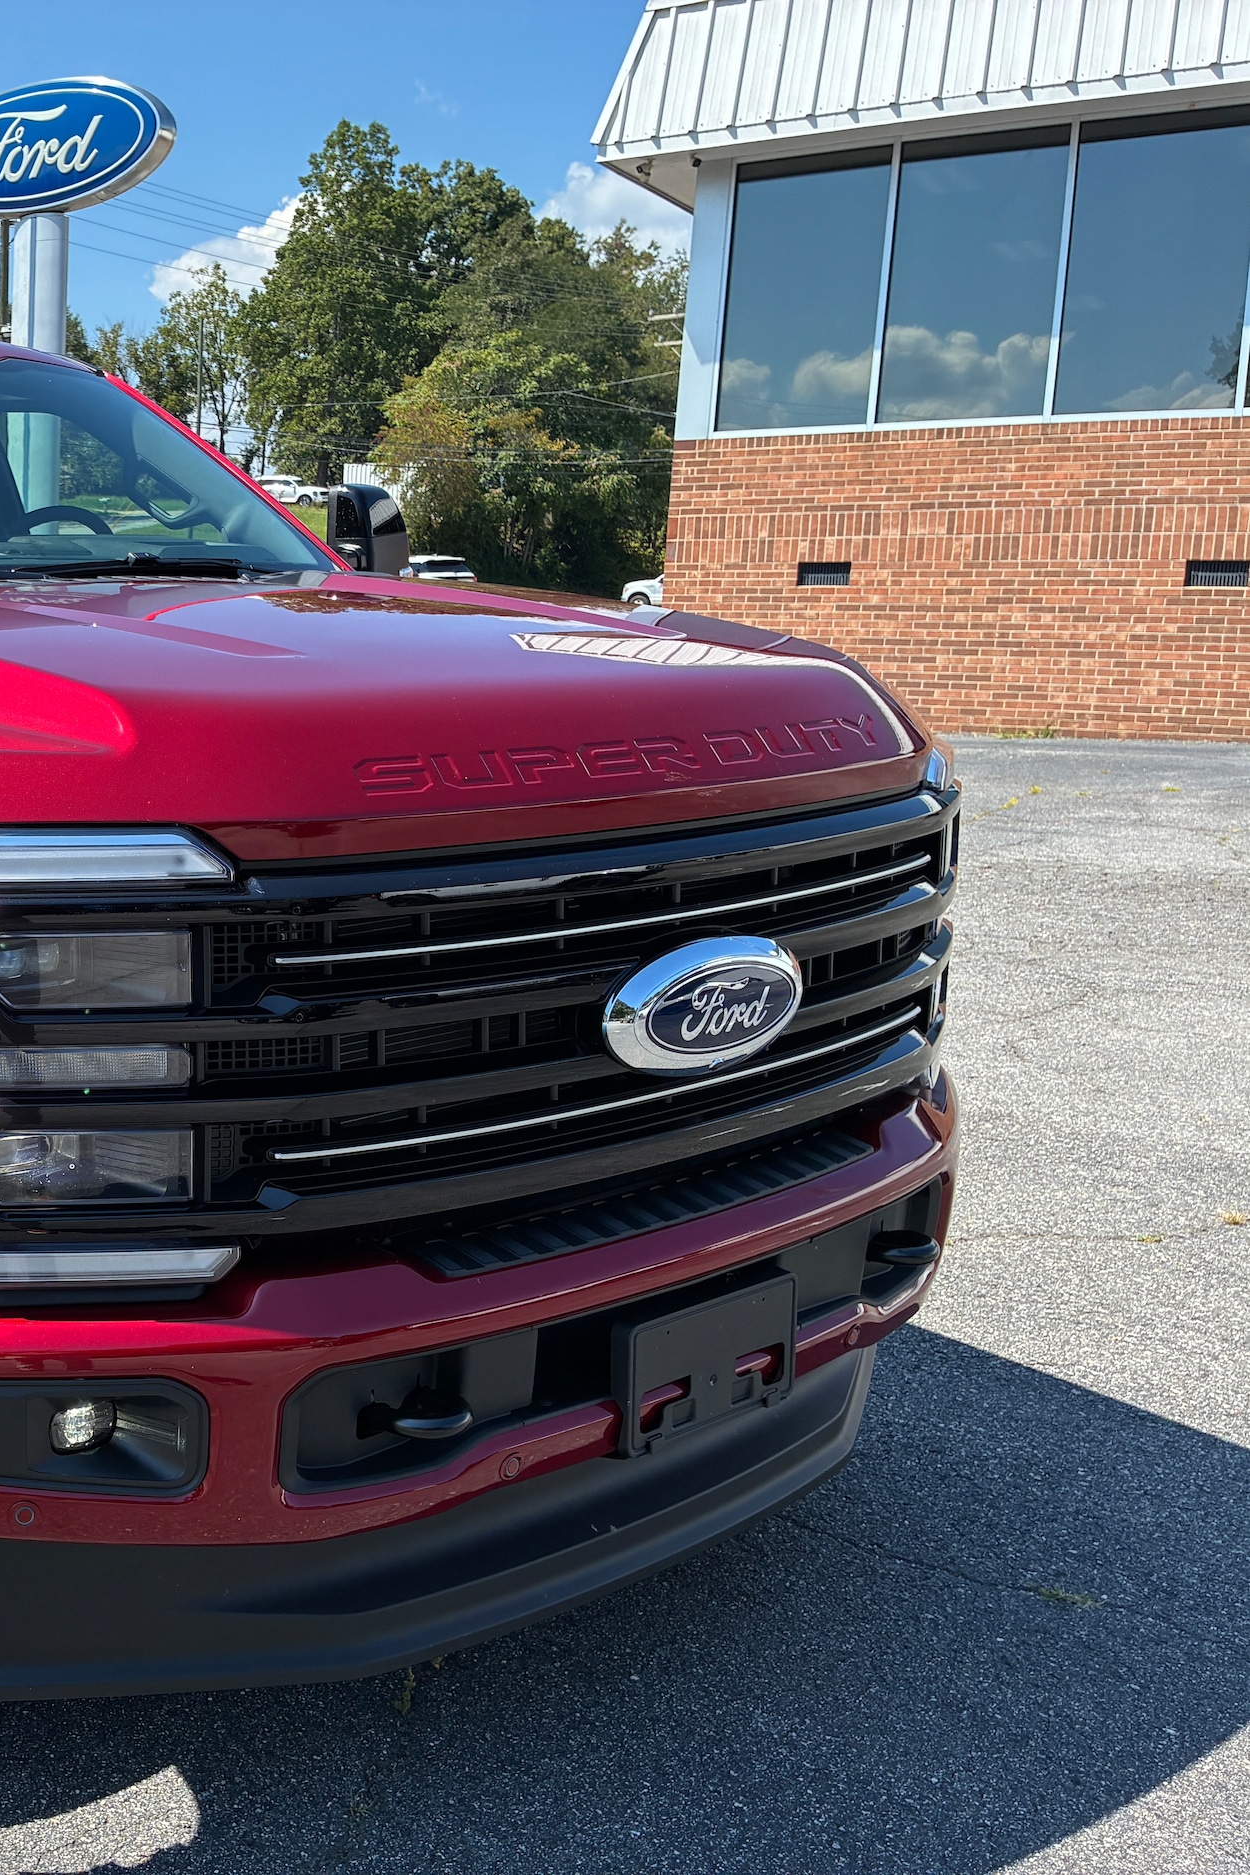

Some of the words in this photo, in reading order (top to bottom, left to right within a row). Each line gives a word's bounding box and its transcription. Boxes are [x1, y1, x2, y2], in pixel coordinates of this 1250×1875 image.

[352, 735, 701, 797] SUPER
[702, 713, 877, 766] DUTY
[681, 976, 770, 1042] Ford
